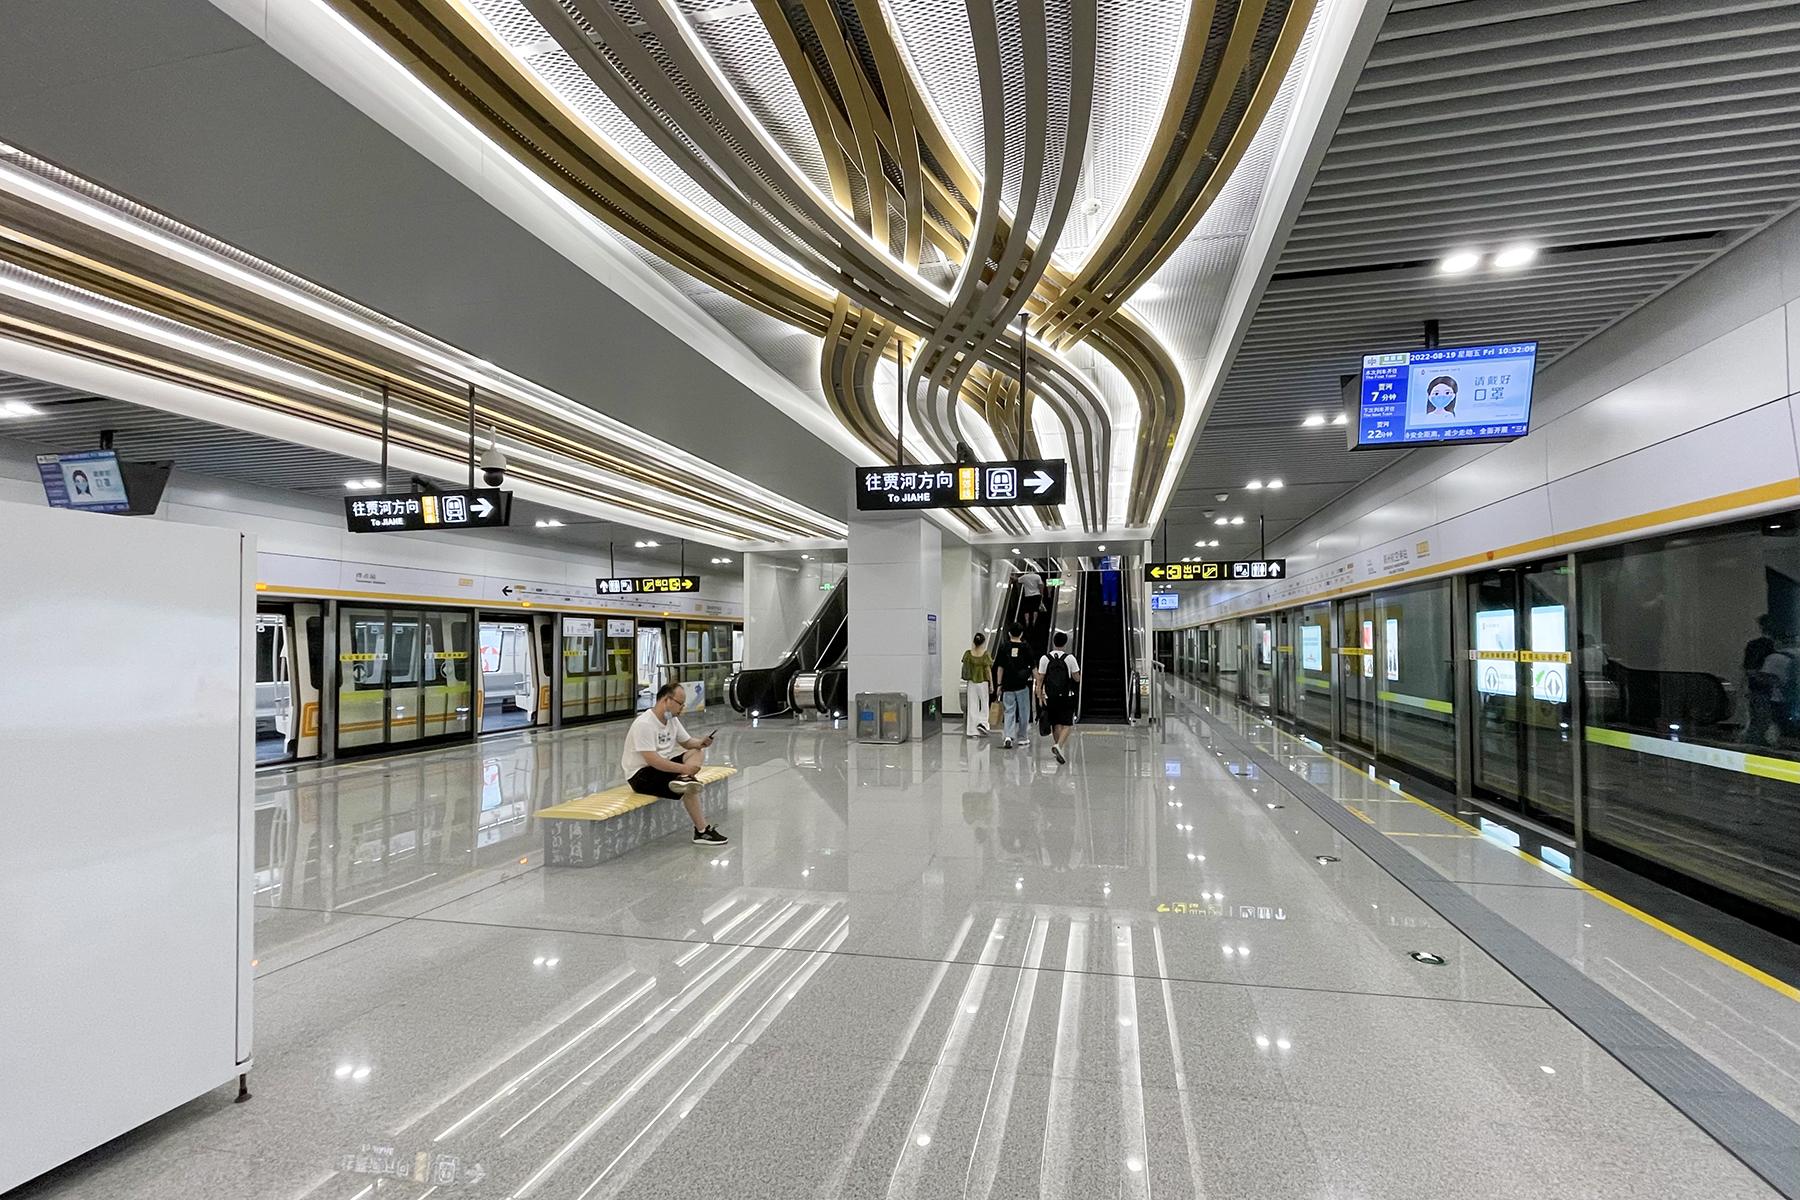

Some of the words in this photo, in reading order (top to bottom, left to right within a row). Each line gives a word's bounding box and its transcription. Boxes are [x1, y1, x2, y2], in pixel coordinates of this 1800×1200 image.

[1410, 351, 1456, 361] 2022-08-19
[1458, 349, 1480, 358] 星期五
[1483, 348, 1494, 356] Fri
[1498, 345, 1535, 355] 10:32:09
[1474, 374, 1511, 386] 请戴好
[1378, 383, 1392, 391] 贾河
[1371, 392, 1379, 402] 7
[1381, 393, 1396, 401] 分钟
[1474, 386, 1504, 401] 口罩
[865, 471, 953, 491] 往贾河方向
[888, 493, 900, 503] To
[902, 492, 931, 502] JIAHE
[352, 499, 419, 517] 往贾河方向
[371, 518, 380, 526] To
[382, 517, 404, 526] JIAHE
[1184, 565, 1200, 573] 出口
[655, 579, 668, 587] 出口
